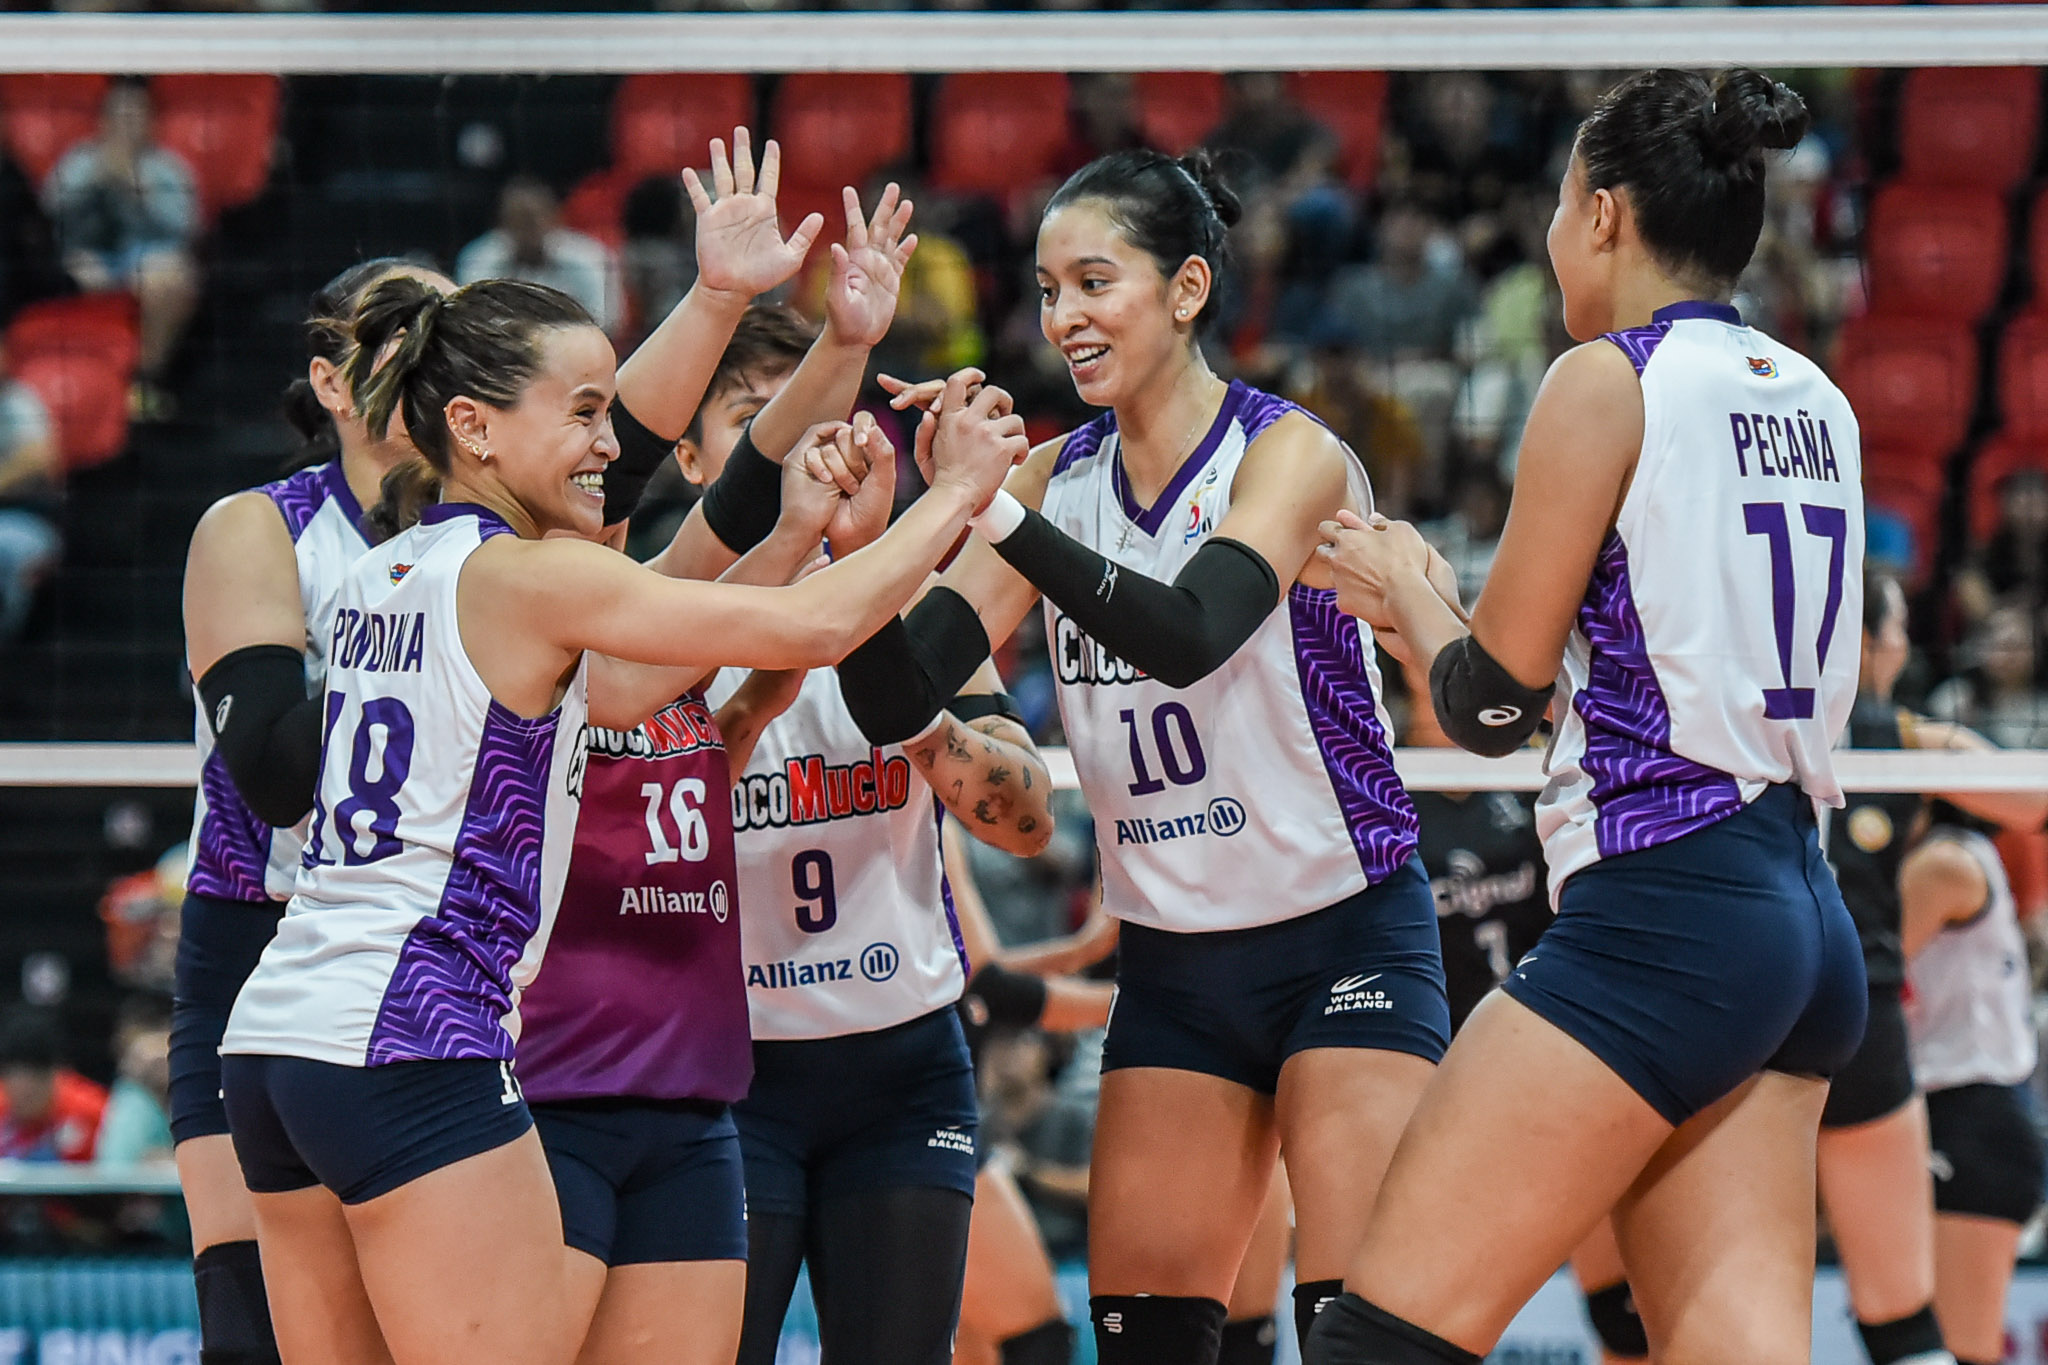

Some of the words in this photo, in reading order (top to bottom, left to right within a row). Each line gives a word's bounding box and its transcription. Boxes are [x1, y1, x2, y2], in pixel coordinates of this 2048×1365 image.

[1729, 409, 1840, 483] PECAÑA
[1742, 502, 1847, 720] 17
[331, 608, 425, 673] PONDINA
[1119, 702, 1207, 797] 10
[301, 687, 415, 871] 18
[640, 777, 710, 866] 16
[1114, 813, 1207, 846] Allianz
[619, 886, 708, 916] Allianz
[791, 848, 838, 934] 9
[747, 959, 853, 989] Allianz
[1330, 990, 1386, 1005] WORLD
[1324, 1000, 1394, 1016] BALANCE
[927, 1137, 975, 1156] BALANCE
[936, 1129, 973, 1145] WORLD
